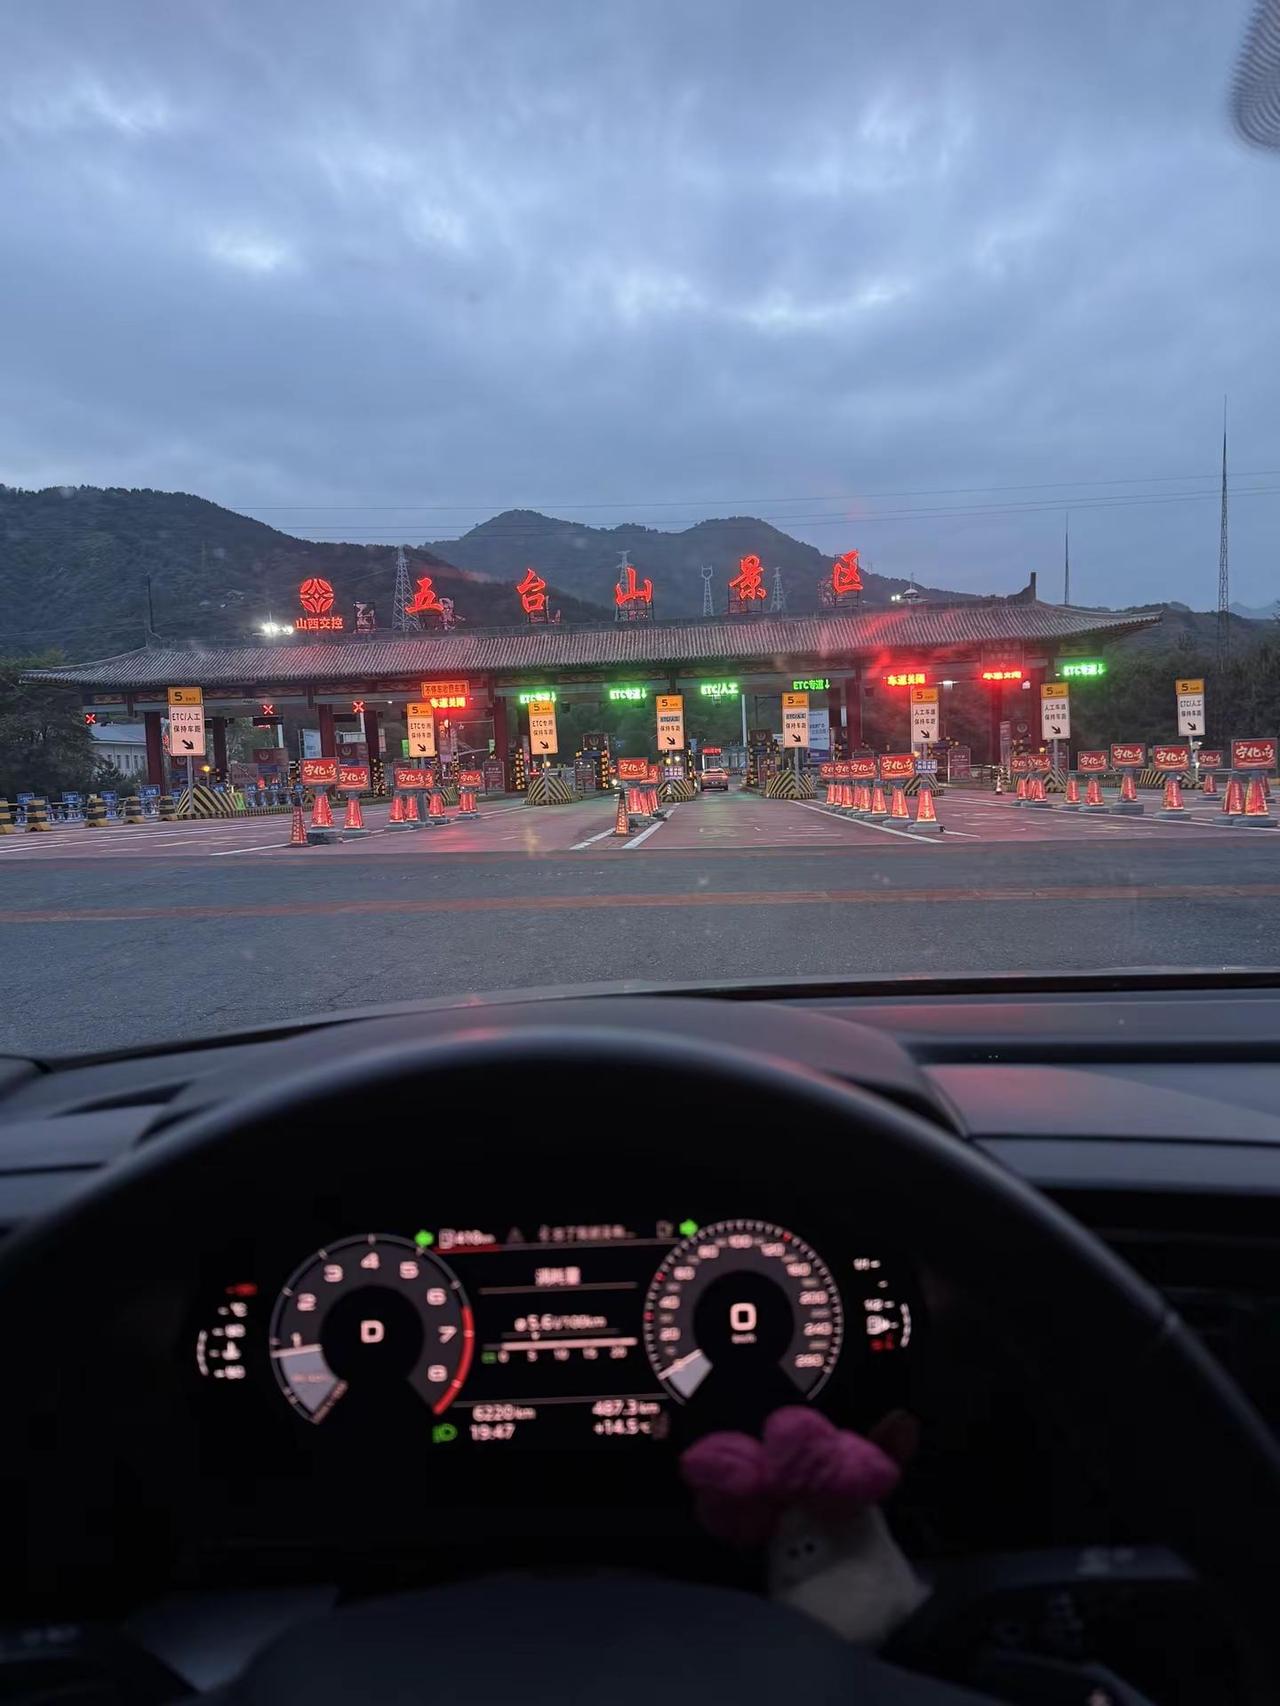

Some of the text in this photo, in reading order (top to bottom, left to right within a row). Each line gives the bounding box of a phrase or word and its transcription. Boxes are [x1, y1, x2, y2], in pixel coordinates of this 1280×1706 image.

[405, 549, 864, 613] 五台山景区
[296, 617, 343, 630] 山西交控
[700, 682, 739, 696] ETC/人工
[1046, 687, 1054, 695] 5
[1181, 683, 1188, 691] 5
[174, 691, 183, 701] 5
[787, 696, 795, 704] 5
[916, 691, 923, 699] 5
[533, 704, 540, 712] 5
[661, 699, 668, 707] 5
[411, 706, 419, 714] 5
[172, 713, 201, 721] ETC/人工
[173, 725, 201, 733] 保持车距
[360, 1252, 380, 1269] 4
[324, 1264, 343, 1282] 3
[400, 1261, 419, 1279] 5
[297, 1293, 317, 1311] 2
[427, 1288, 447, 1306] 6
[730, 1303, 757, 1331] 0
[361, 1320, 384, 1344] D
[438, 1325, 457, 1344] 7
